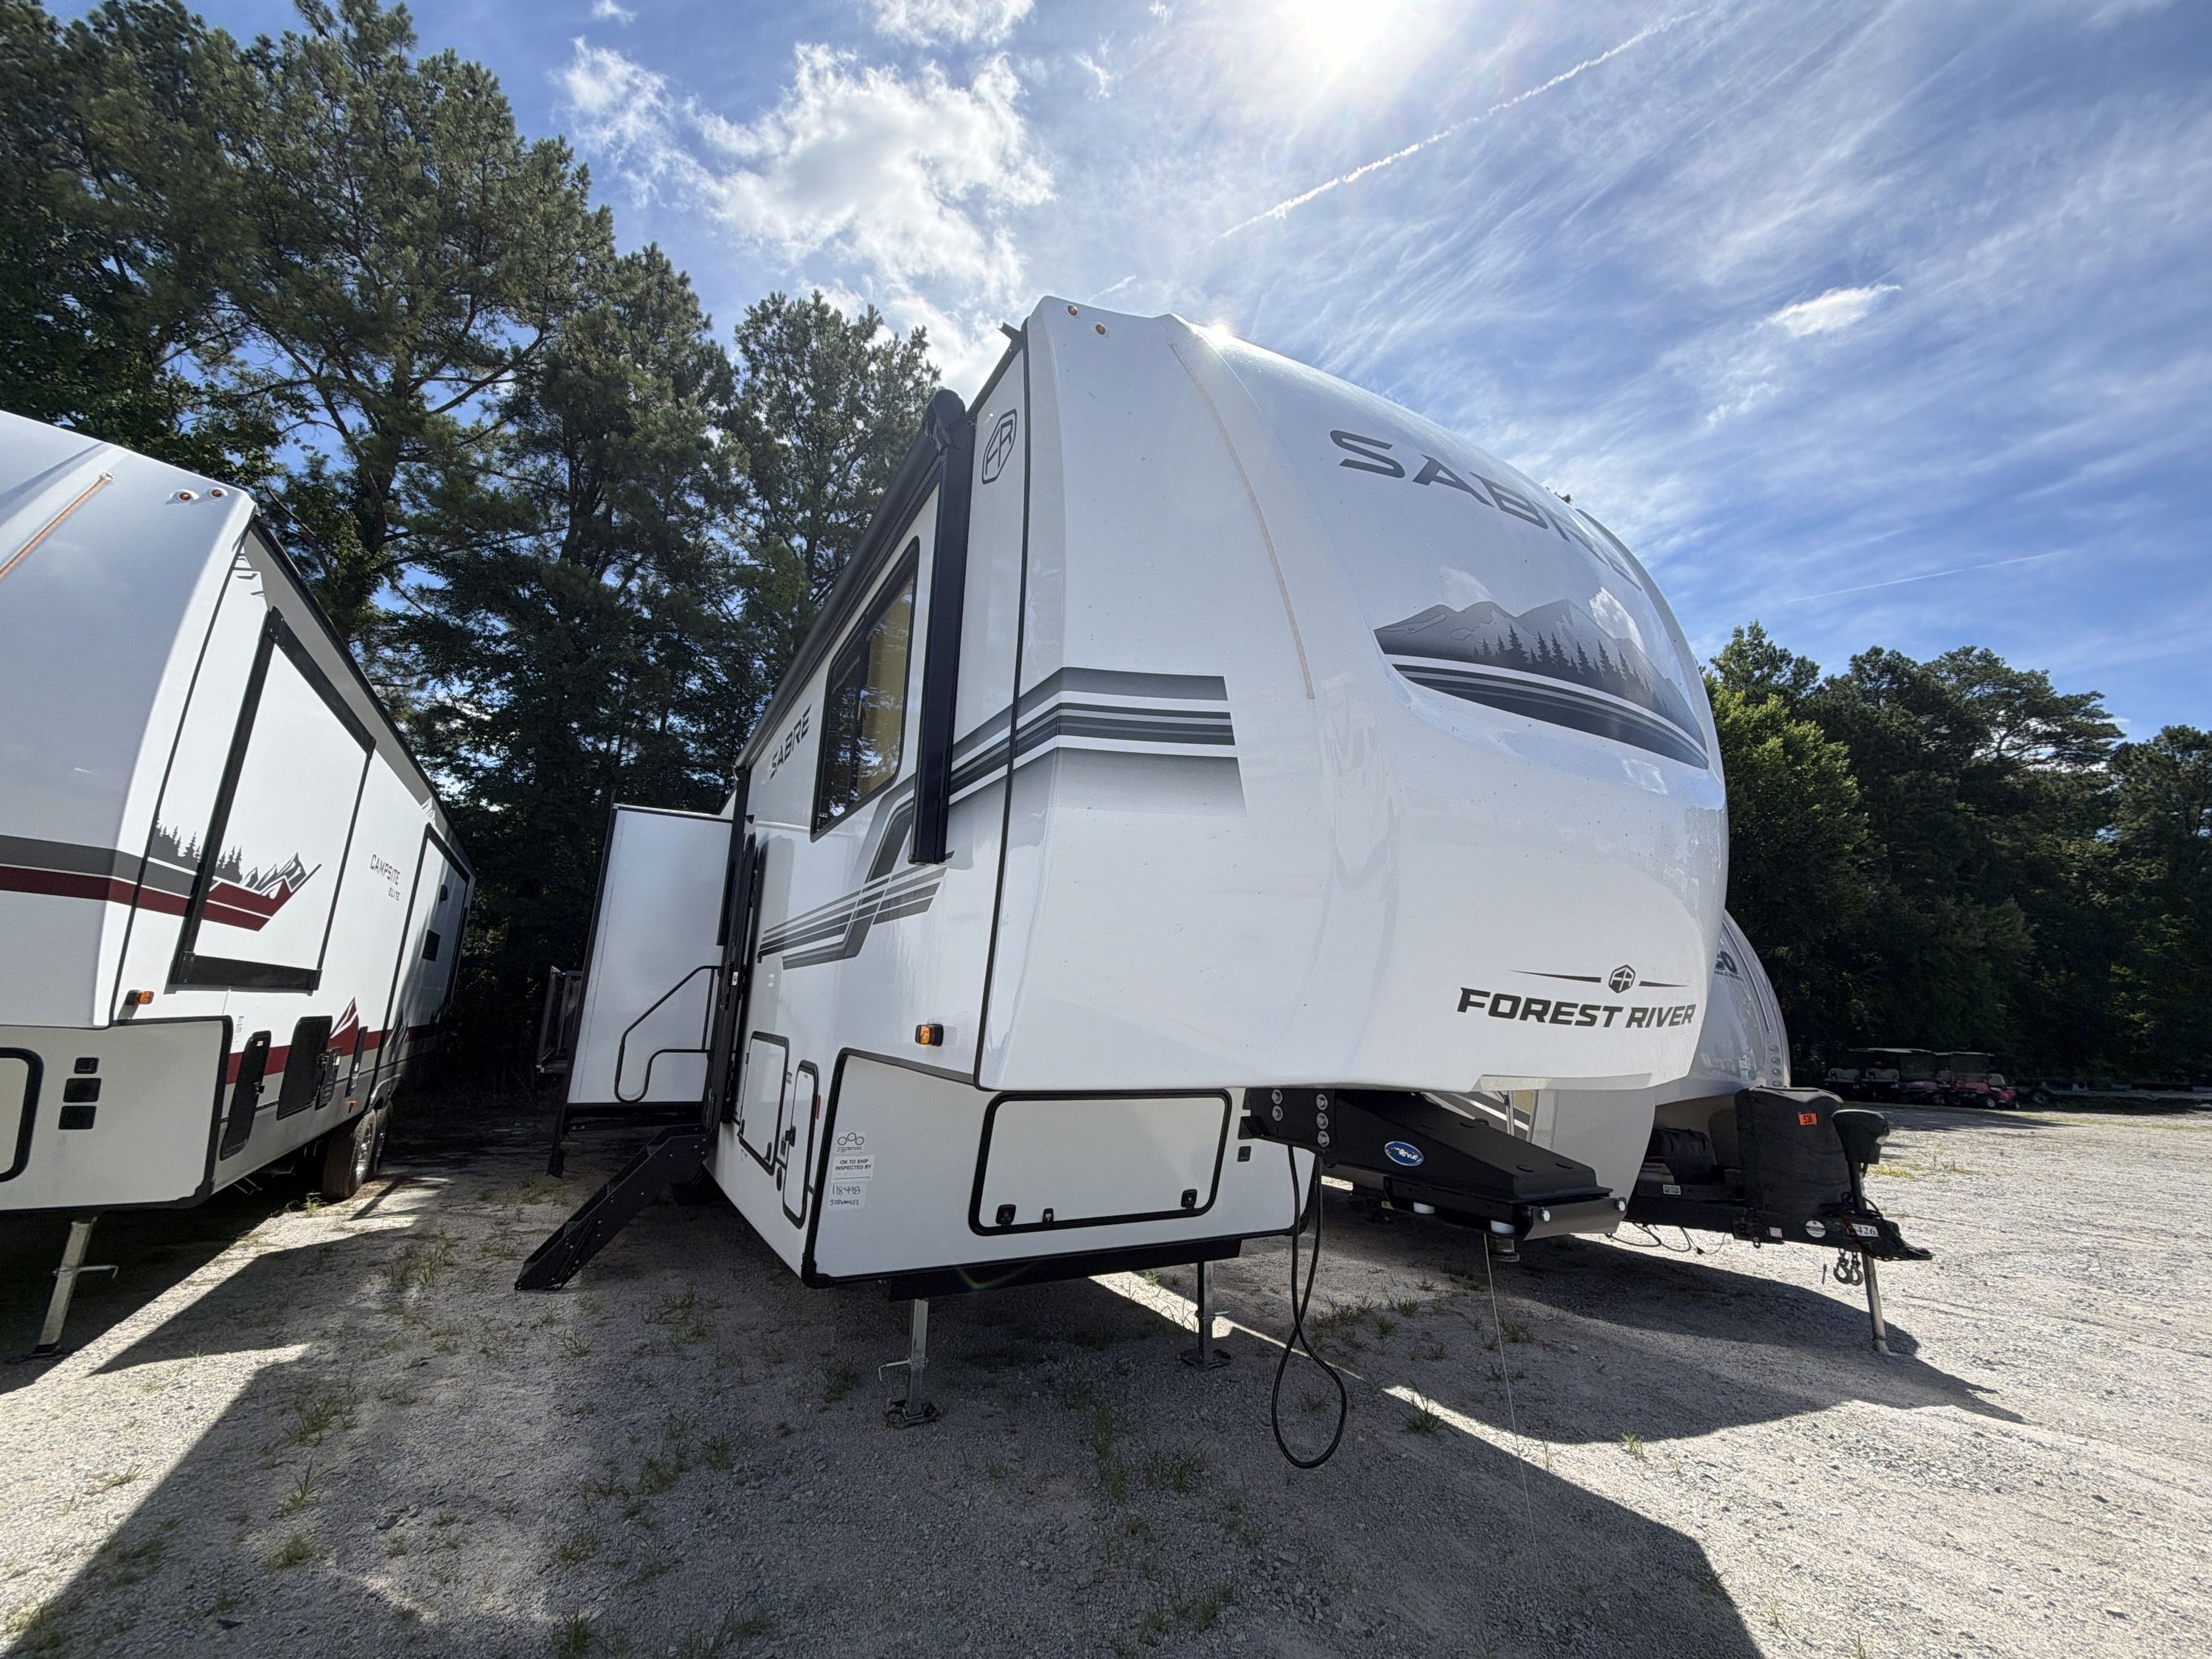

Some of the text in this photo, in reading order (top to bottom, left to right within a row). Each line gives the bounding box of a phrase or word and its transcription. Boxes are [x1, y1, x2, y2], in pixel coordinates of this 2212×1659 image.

[769, 703, 813, 780] SABRE
[370, 854, 400, 886] CAMPSITE
[388, 887, 400, 901] ELITE
[1457, 987, 1697, 1029] FOREST RIVER
